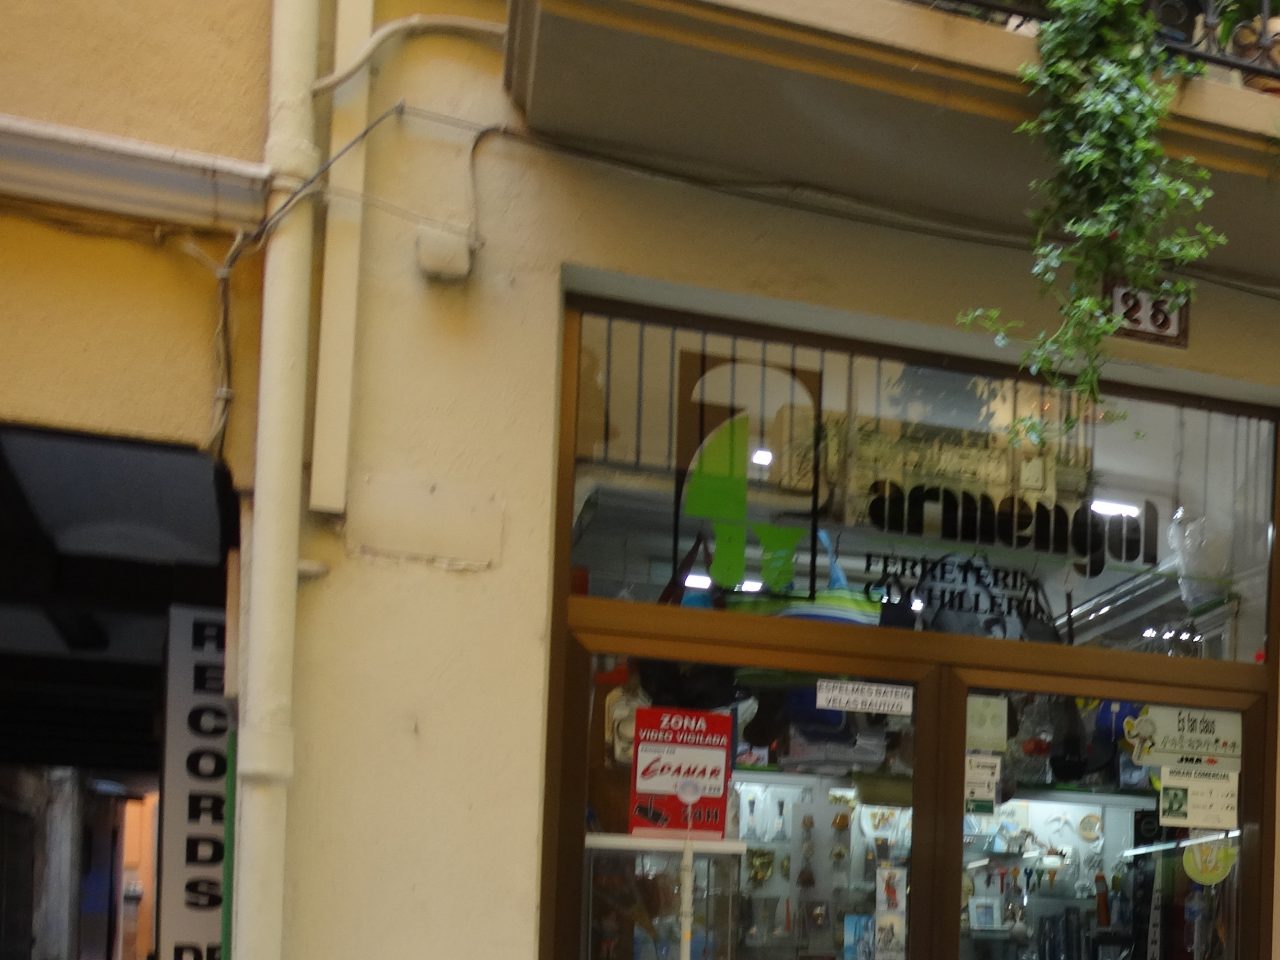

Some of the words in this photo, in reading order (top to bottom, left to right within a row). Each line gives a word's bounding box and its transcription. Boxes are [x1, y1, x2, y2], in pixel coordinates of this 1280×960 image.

[868, 479, 1158, 579] armengol
[639, 728, 674, 742] VIDEO
[676, 731, 728, 746] VIGILADA
[660, 713, 707, 732] ZONA
[184, 619, 229, 911] RECORDS
